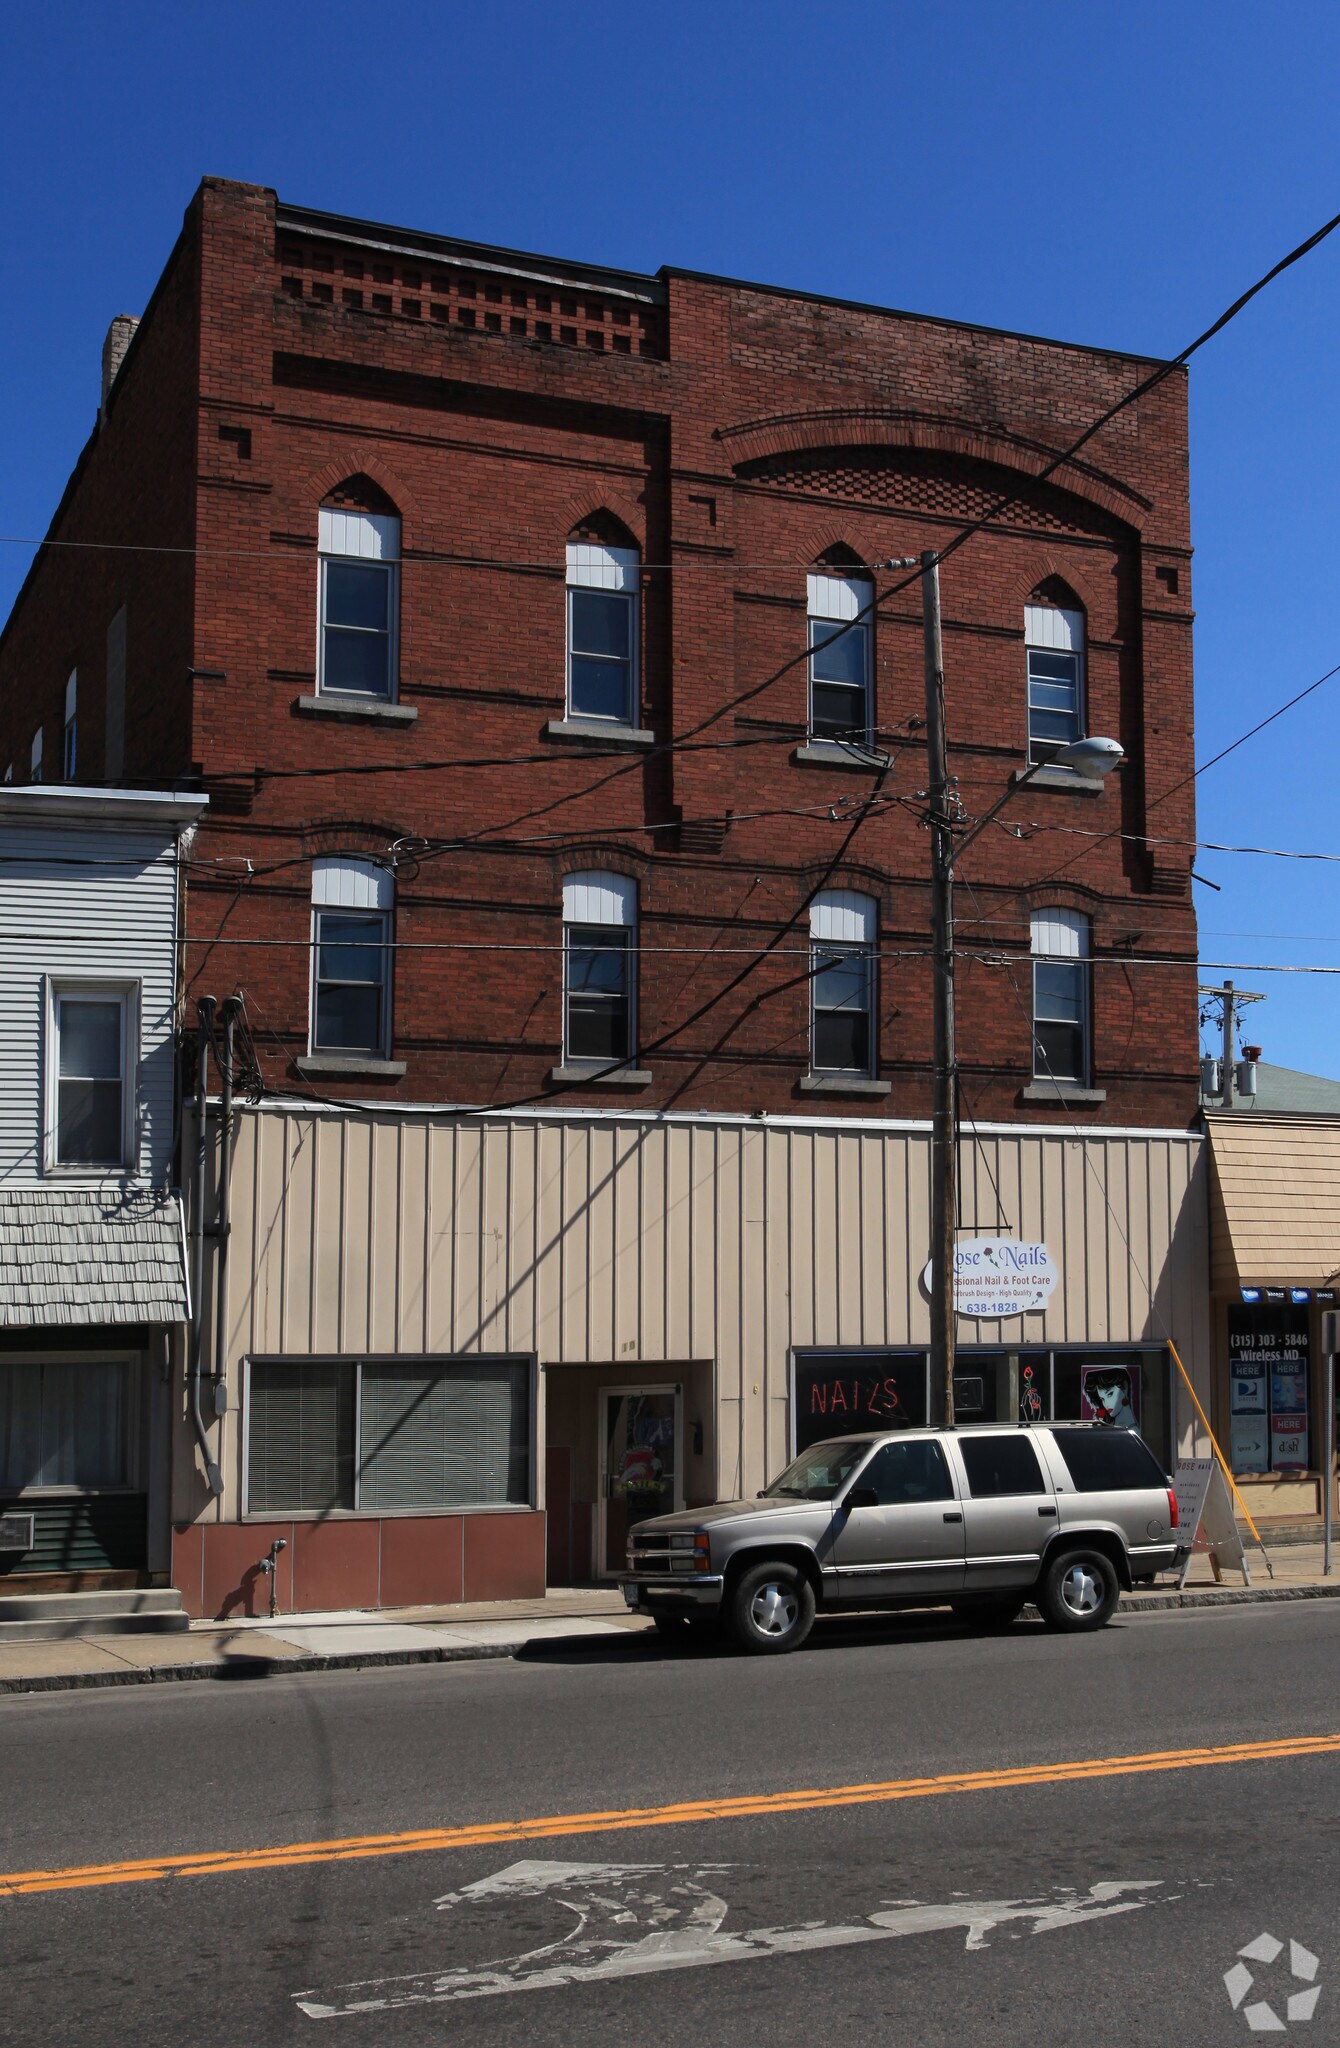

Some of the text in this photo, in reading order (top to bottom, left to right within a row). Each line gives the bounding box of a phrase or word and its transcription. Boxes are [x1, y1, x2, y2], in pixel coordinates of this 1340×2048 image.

[953, 1246, 1047, 1274] ose Nails
[953, 1275, 1051, 1286] ssional Nail & Foot Care
[976, 1289, 994, 1298] Design
[999, 1289, 1012, 1298] High
[1013, 1289, 1033, 1298] Quality
[966, 1303, 1018, 1313] 638-1828
[1230, 1333, 1255, 1348] (315)
[1258, 1334, 1275, 1346] 303
[1285, 1334, 1308, 1346] 5846
[1239, 1349, 1299, 1362] Wireless MD
[1236, 1366, 1260, 1375] HERE
[1277, 1365, 1300, 1374] HERE
[811, 1378, 899, 1415] NAILS
[1277, 1420, 1301, 1429] HERE
[1177, 1462, 1196, 1470] ROSE
